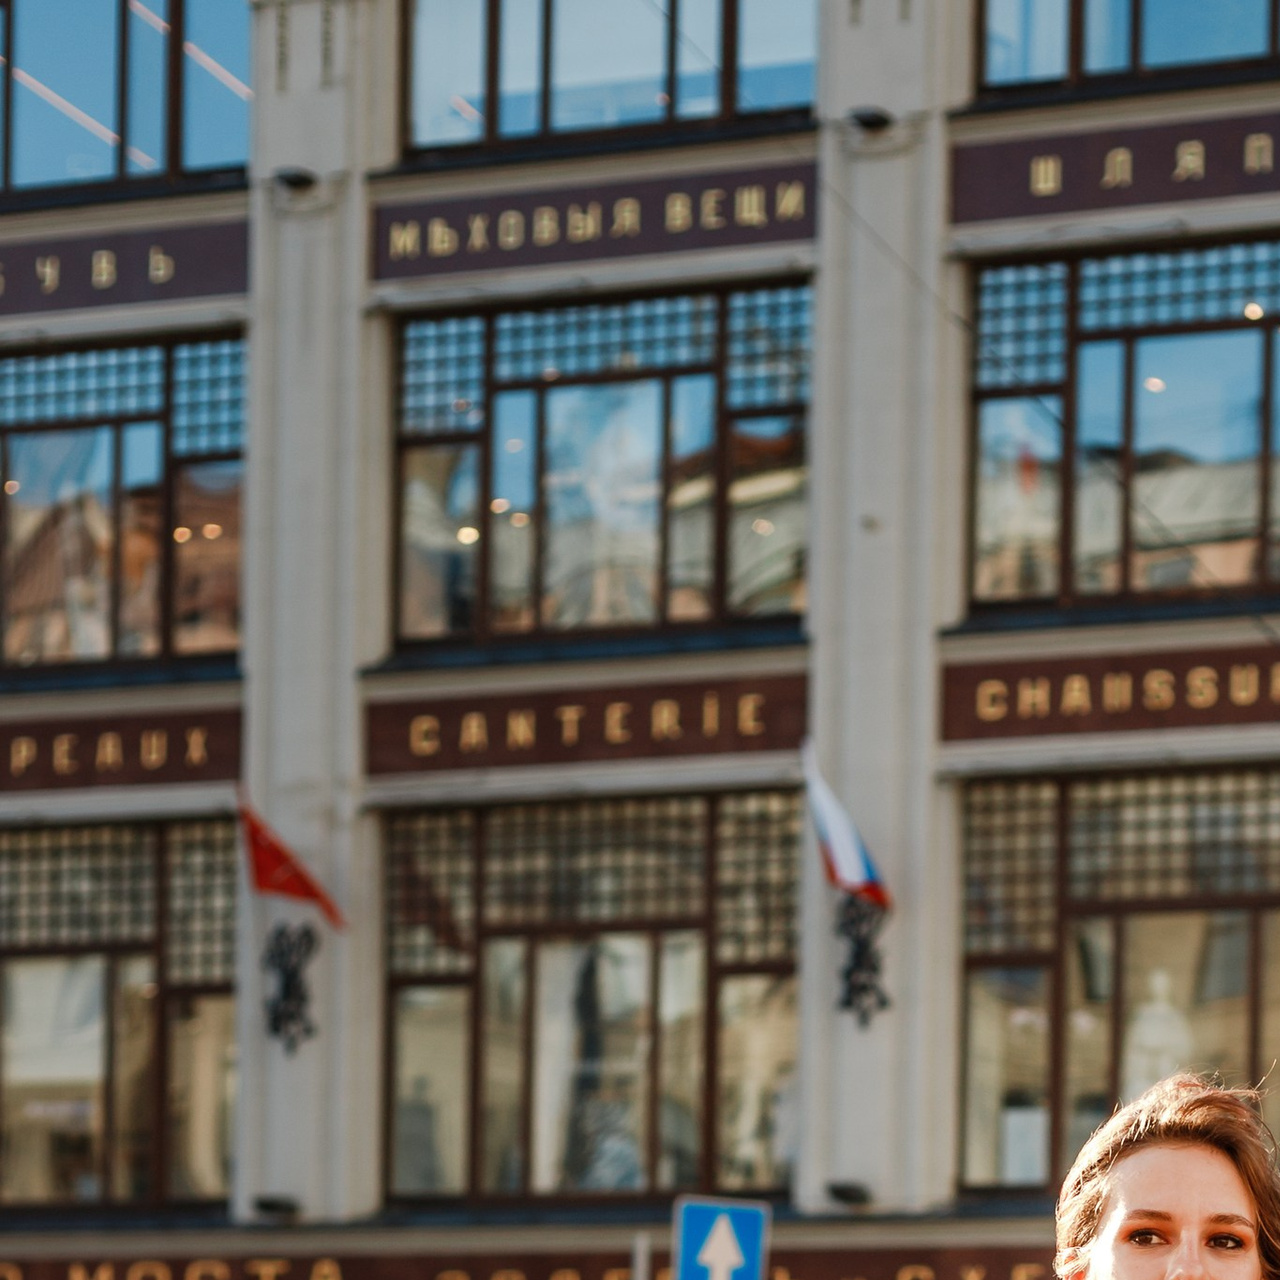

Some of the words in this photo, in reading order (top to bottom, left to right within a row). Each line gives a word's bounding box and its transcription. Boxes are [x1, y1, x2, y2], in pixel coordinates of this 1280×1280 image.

[665, 179, 805, 234] ВЕЩИ
[0, 245, 175, 296] УВЬ
[10, 726, 208, 778] PEAUX
